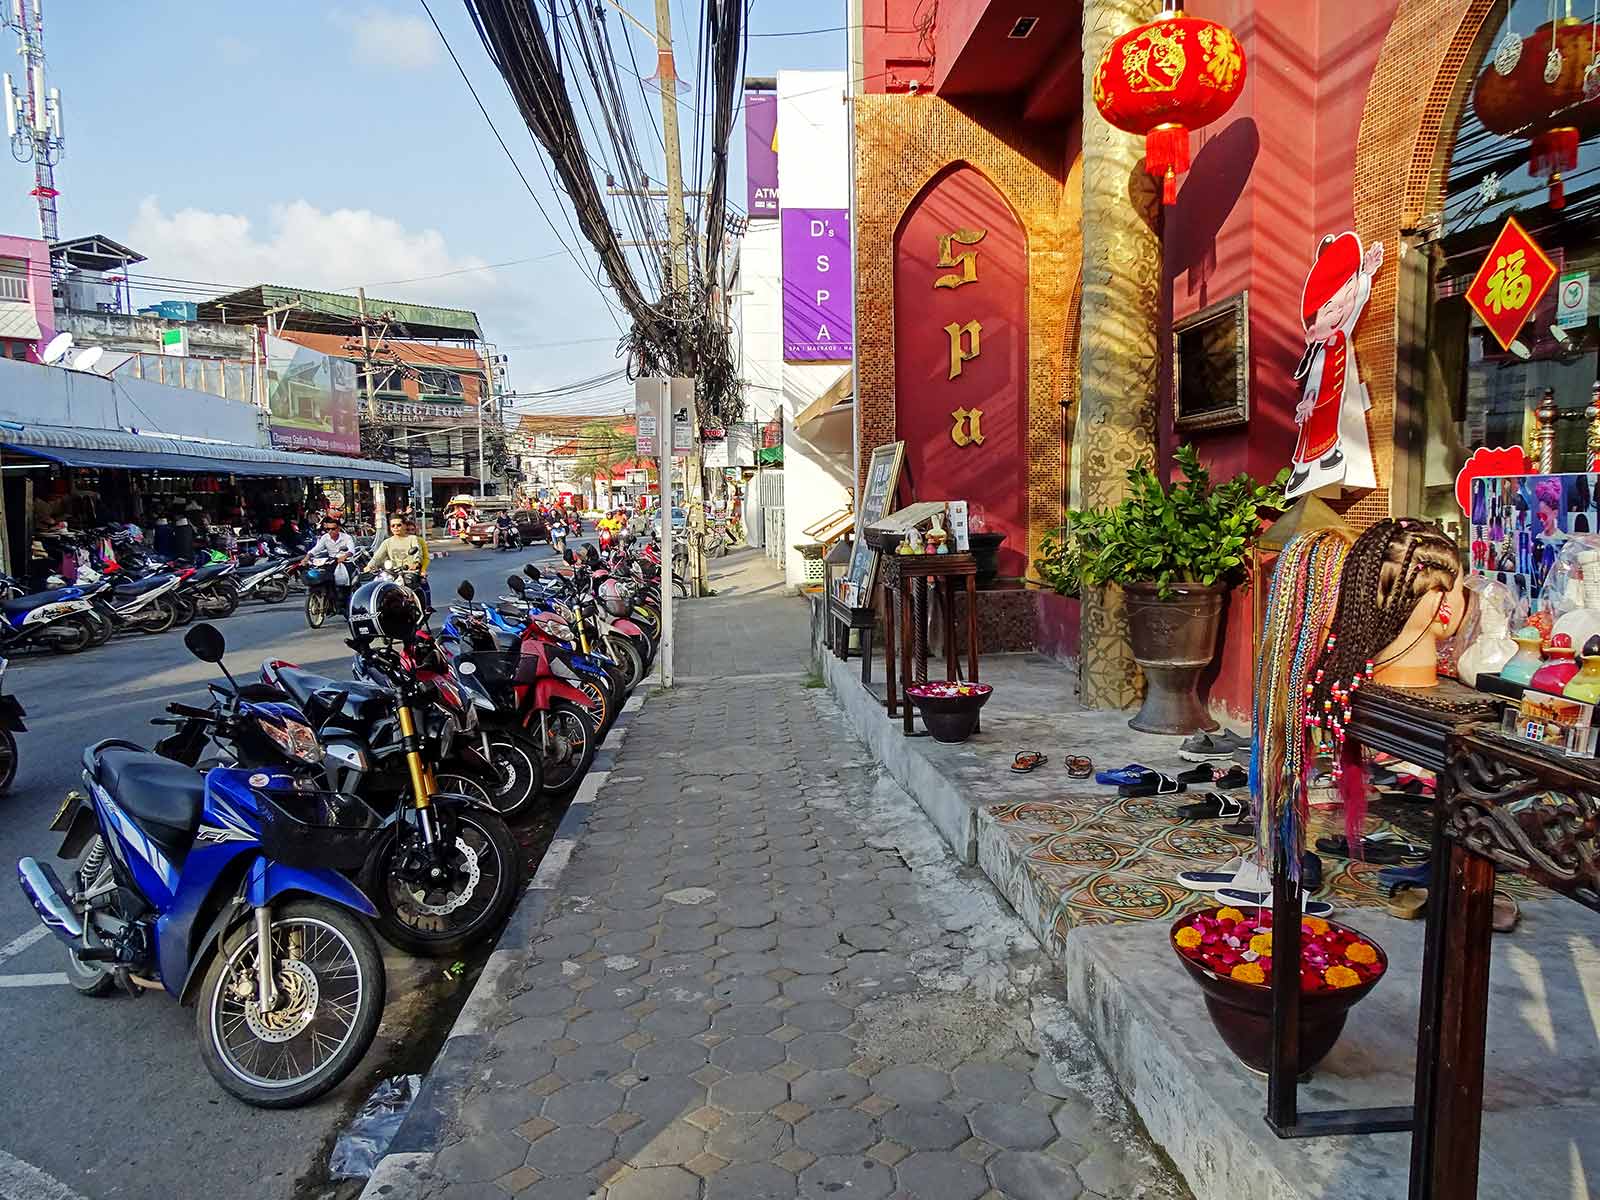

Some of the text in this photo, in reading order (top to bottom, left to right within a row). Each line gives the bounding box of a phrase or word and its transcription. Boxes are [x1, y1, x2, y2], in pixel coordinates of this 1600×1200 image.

[754, 187, 780, 199] ATM
[810, 219, 835, 237] D's
[1484, 248, 1532, 315] 福
